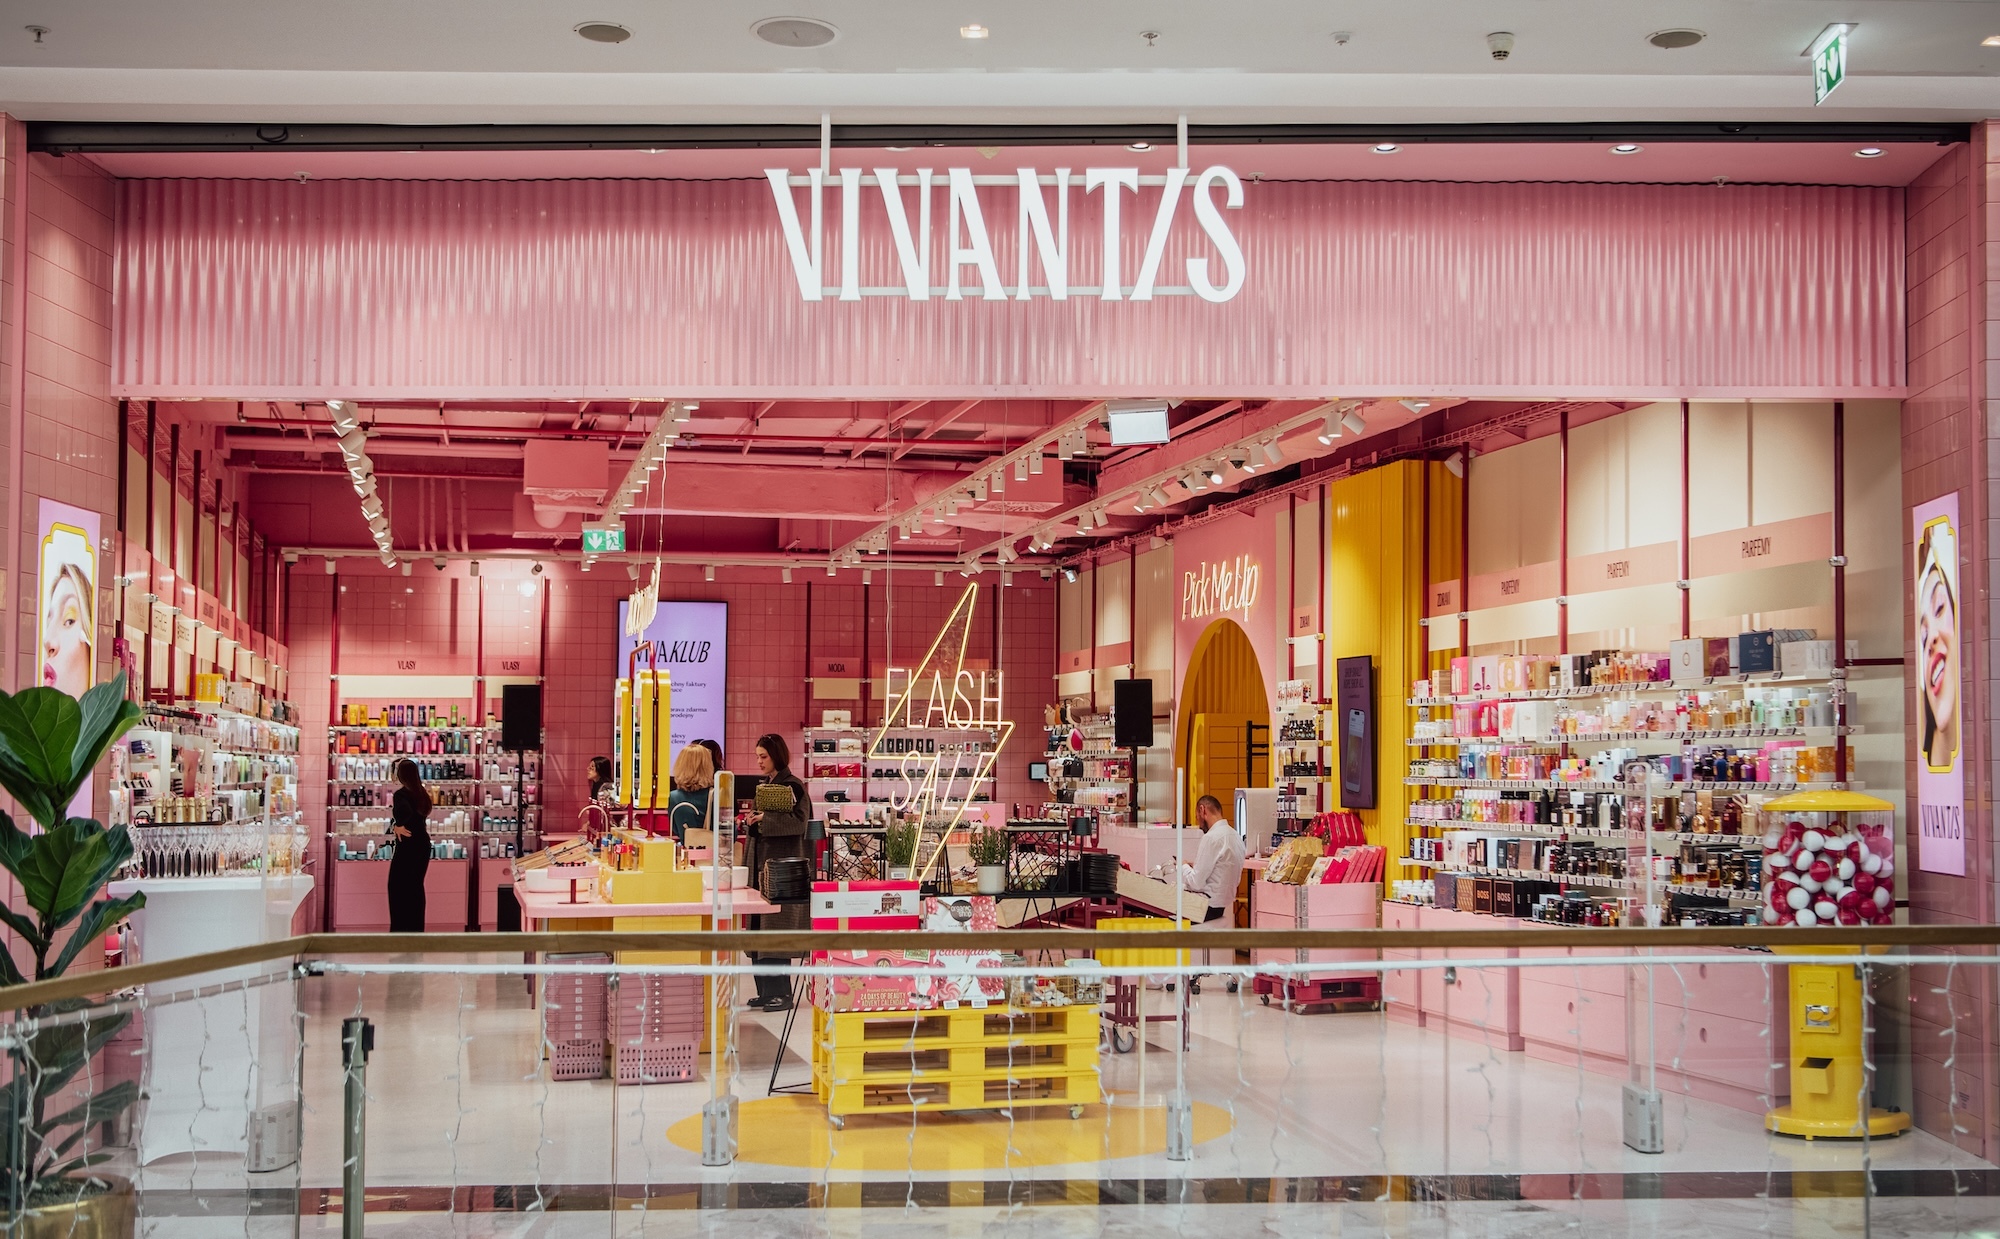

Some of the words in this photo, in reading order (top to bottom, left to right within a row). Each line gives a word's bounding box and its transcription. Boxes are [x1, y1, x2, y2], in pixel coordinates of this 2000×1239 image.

[1181, 561, 1211, 622] Pick
[1210, 560, 1233, 615] Me
[1234, 553, 1259, 622] Up
[397, 660, 417, 670] VLASY
[502, 661, 520, 671] VLASY
[885, 667, 1004, 731] FLASH
[890, 750, 998, 812] SALE
[1476, 890, 1490, 900] BOSS
[1497, 892, 1511, 902] BOSS
